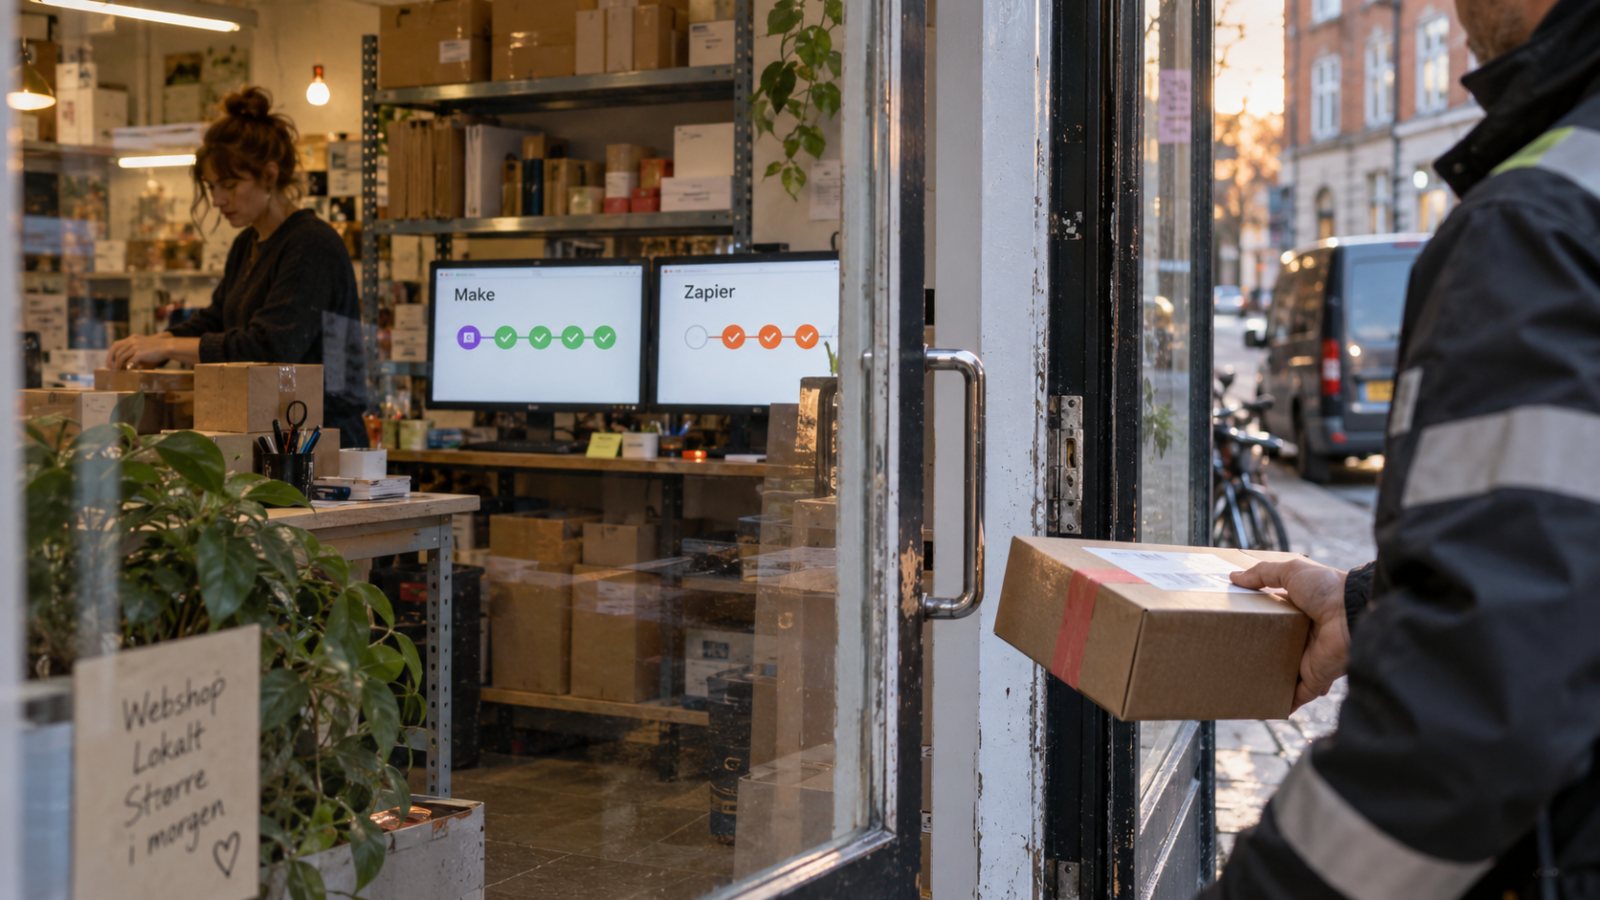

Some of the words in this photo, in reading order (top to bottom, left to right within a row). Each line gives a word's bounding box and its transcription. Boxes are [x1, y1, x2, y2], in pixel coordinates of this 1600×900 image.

[454, 287, 496, 303] Make
[684, 284, 736, 302] Zapier
[123, 677, 226, 732] Webshop
[133, 721, 206, 775] Lokalt
[128, 833, 136, 867] i
[147, 799, 226, 855] morgen
